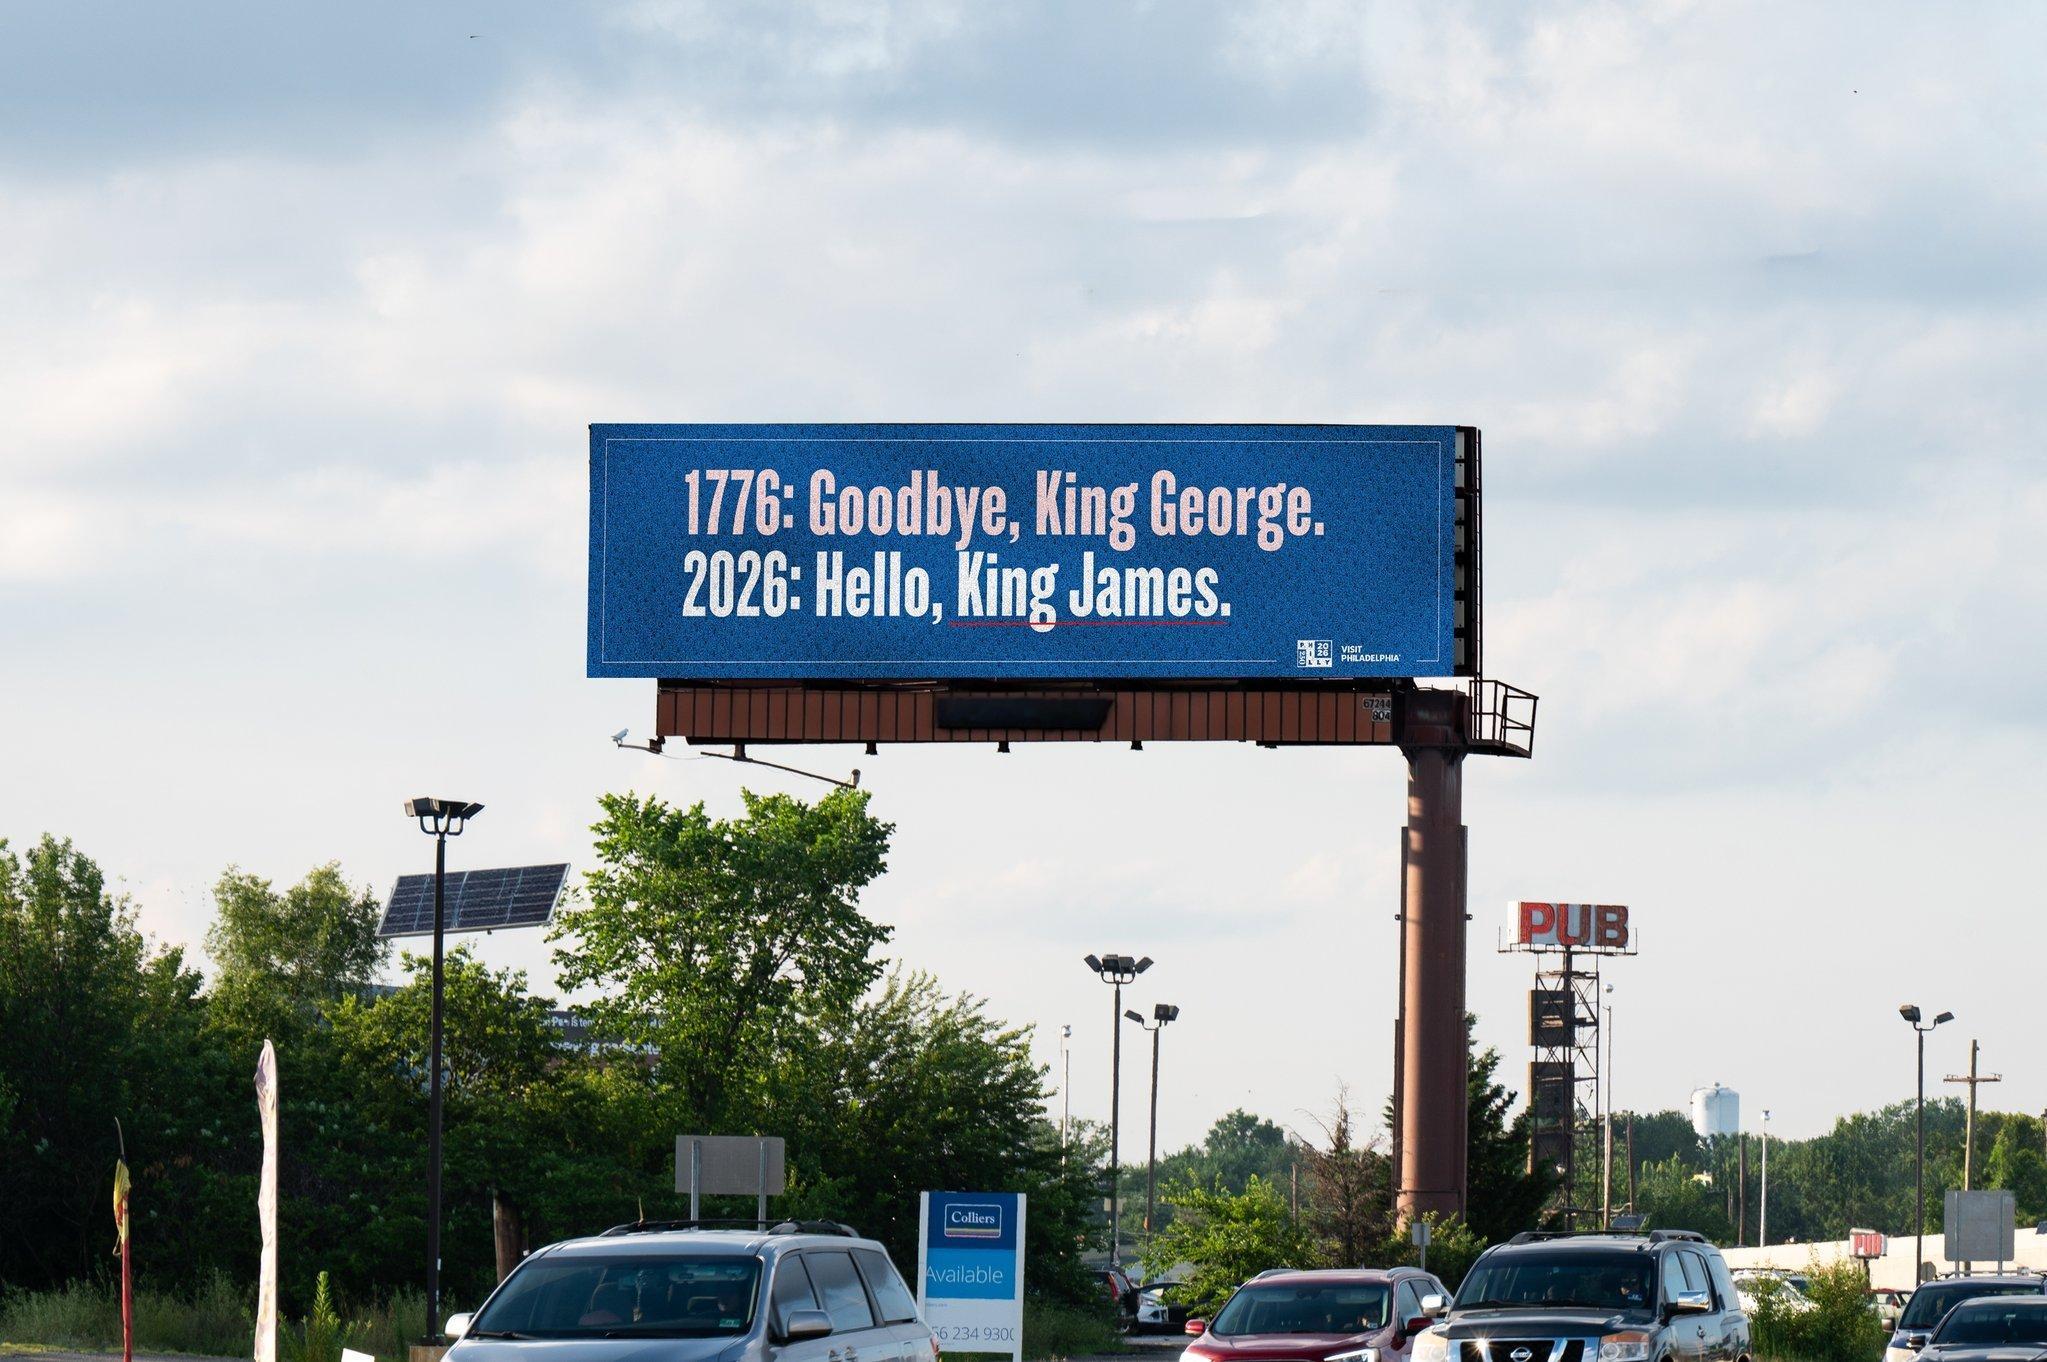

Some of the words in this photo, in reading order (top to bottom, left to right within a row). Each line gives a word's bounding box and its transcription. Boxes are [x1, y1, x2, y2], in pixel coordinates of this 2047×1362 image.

[685, 469, 793, 535] 1776:
[810, 469, 1019, 550] Goodbye,
[1037, 471, 1138, 551] King
[1151, 470, 1324, 551] George.
[683, 551, 800, 617] 2026:
[816, 552, 942, 624] Hello,
[958, 552, 1059, 632] King
[1070, 552, 1230, 617] James.
[1520, 902, 1629, 946] PUB
[951, 1211, 995, 1224] Colliers
[926, 1265, 1003, 1284] Available
[952, 1326, 979, 1341] 234
